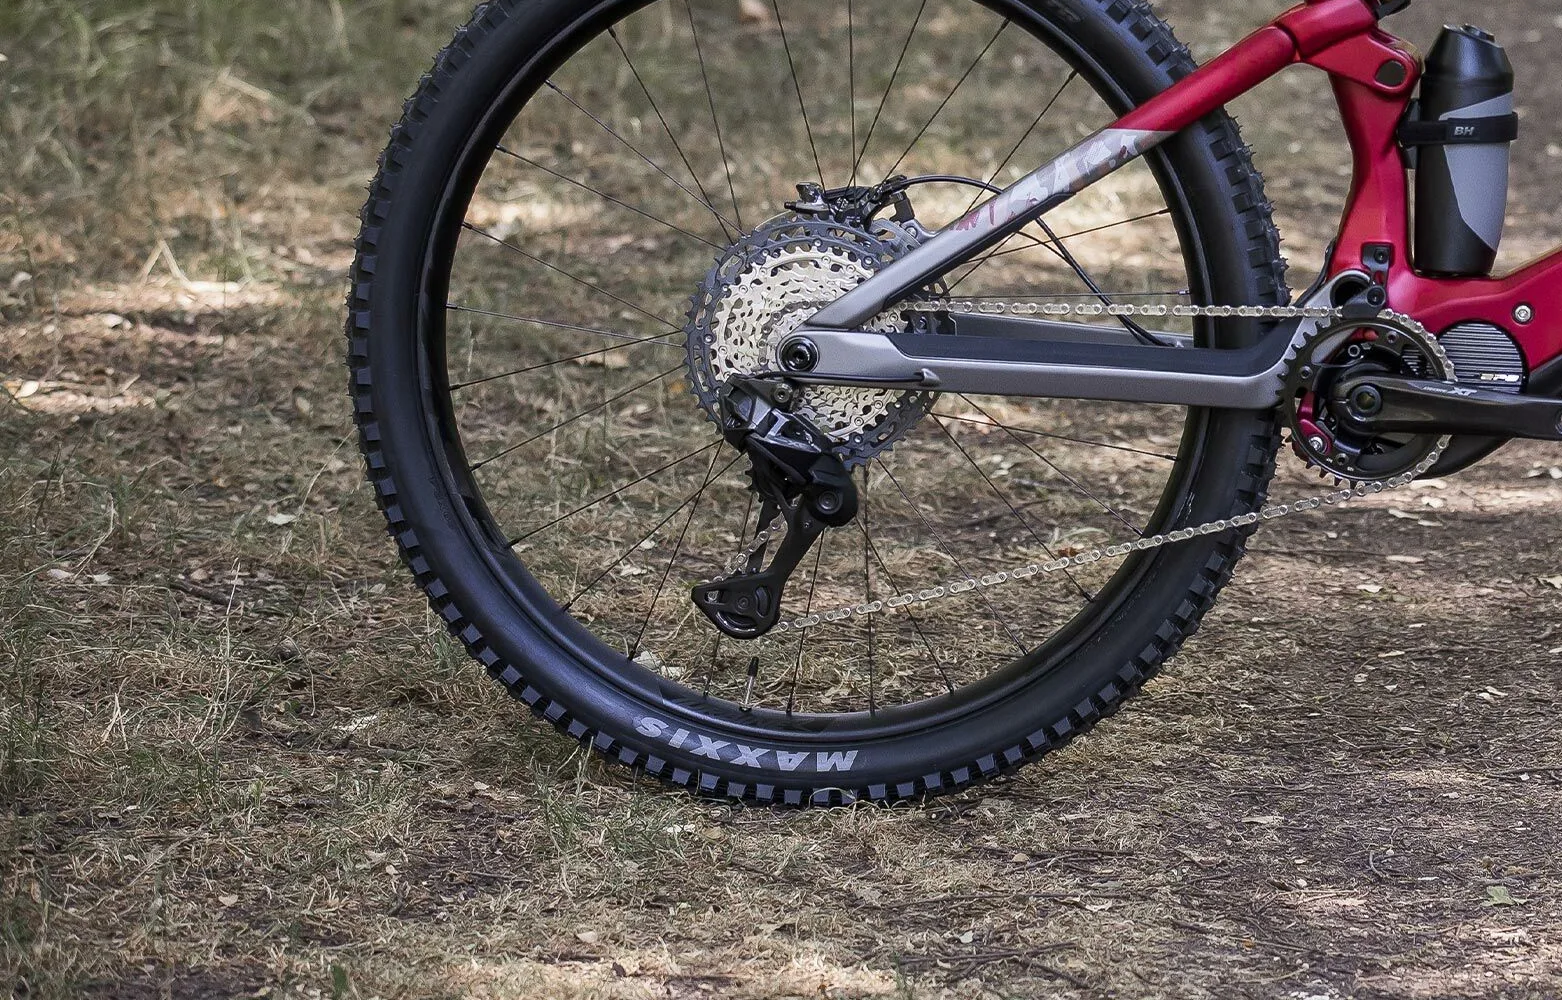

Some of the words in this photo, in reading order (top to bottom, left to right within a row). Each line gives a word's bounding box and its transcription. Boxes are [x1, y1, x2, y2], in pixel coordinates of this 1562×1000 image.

[1454, 126, 1475, 136] BH
[1447, 387, 1478, 396] XT
[634, 716, 858, 772] MAXXIS
